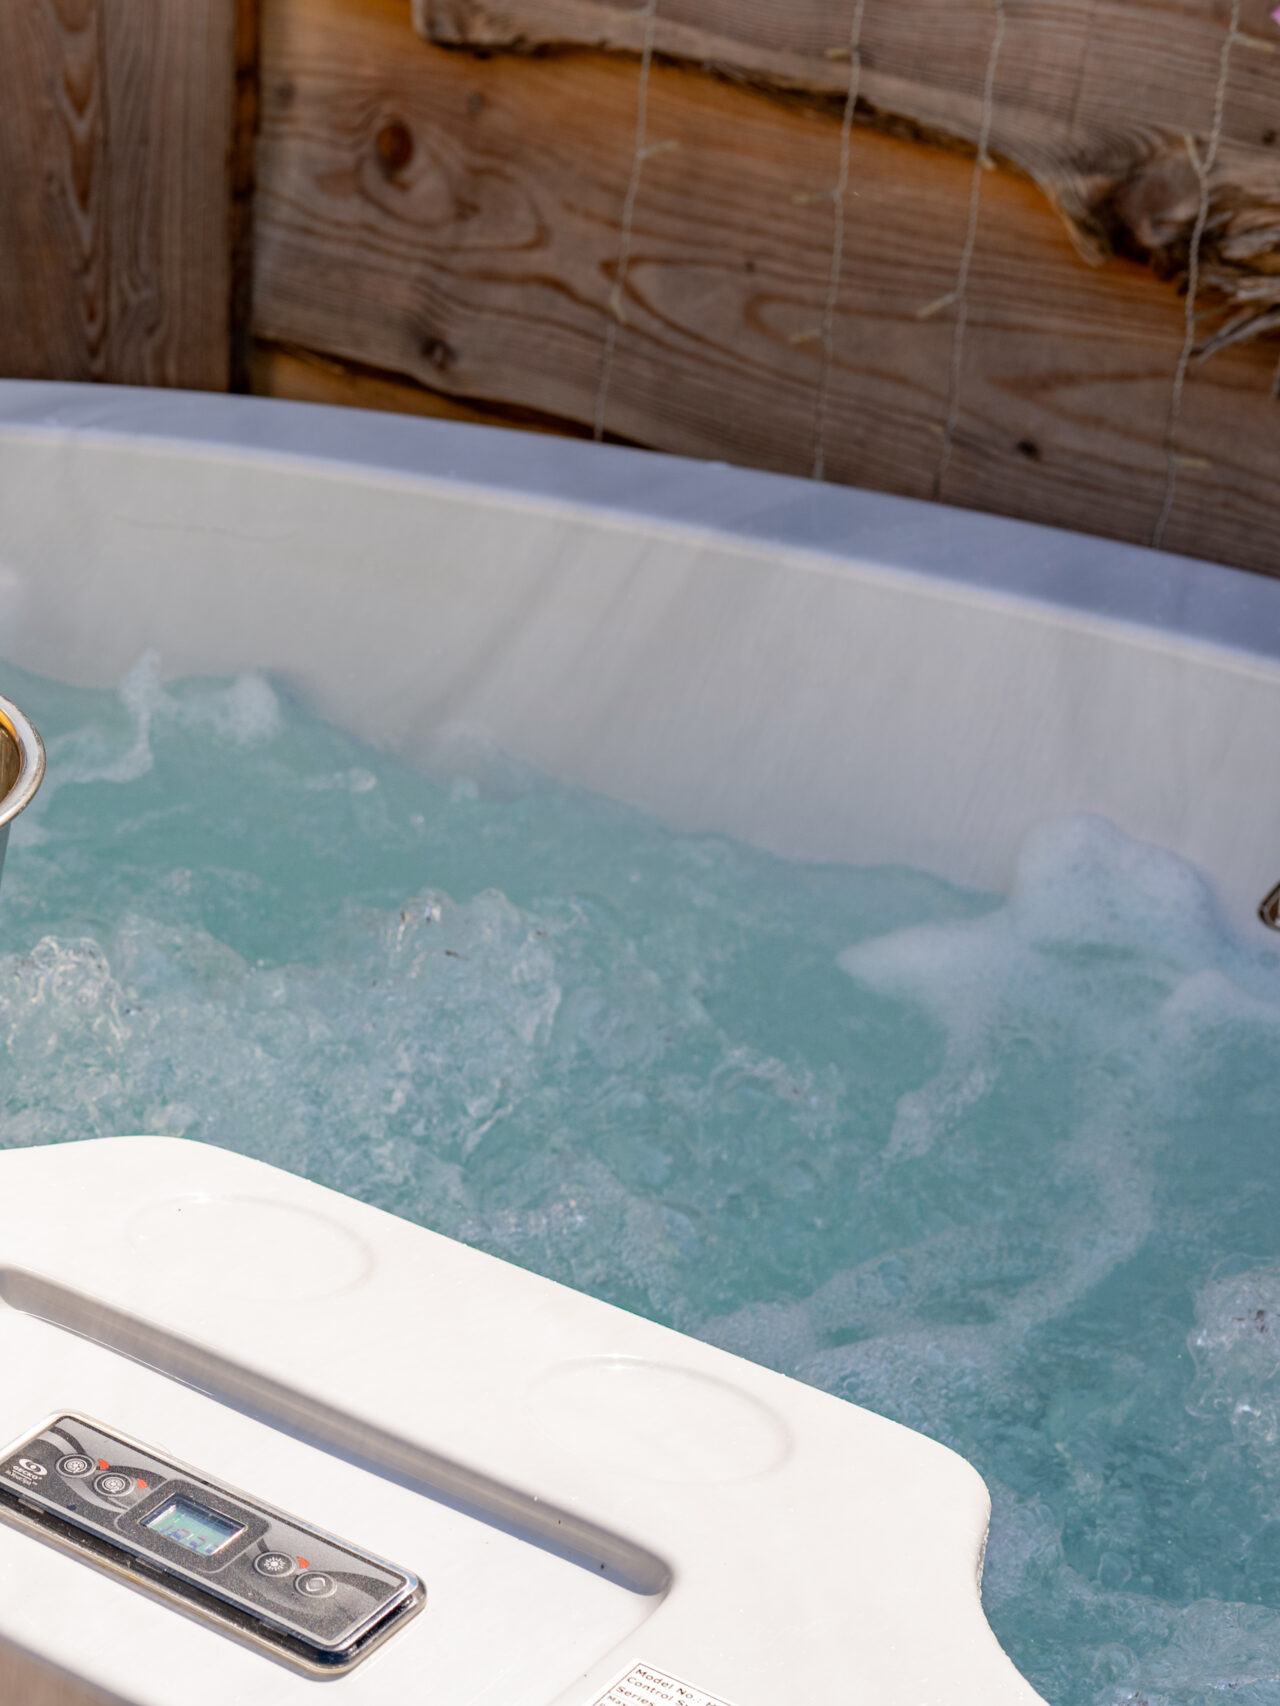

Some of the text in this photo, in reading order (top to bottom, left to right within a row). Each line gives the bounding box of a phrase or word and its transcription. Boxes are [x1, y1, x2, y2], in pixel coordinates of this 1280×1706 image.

[627, 1677, 674, 1701] Control
[635, 1669, 674, 1690] Model
[616, 1686, 656, 1706] Series
